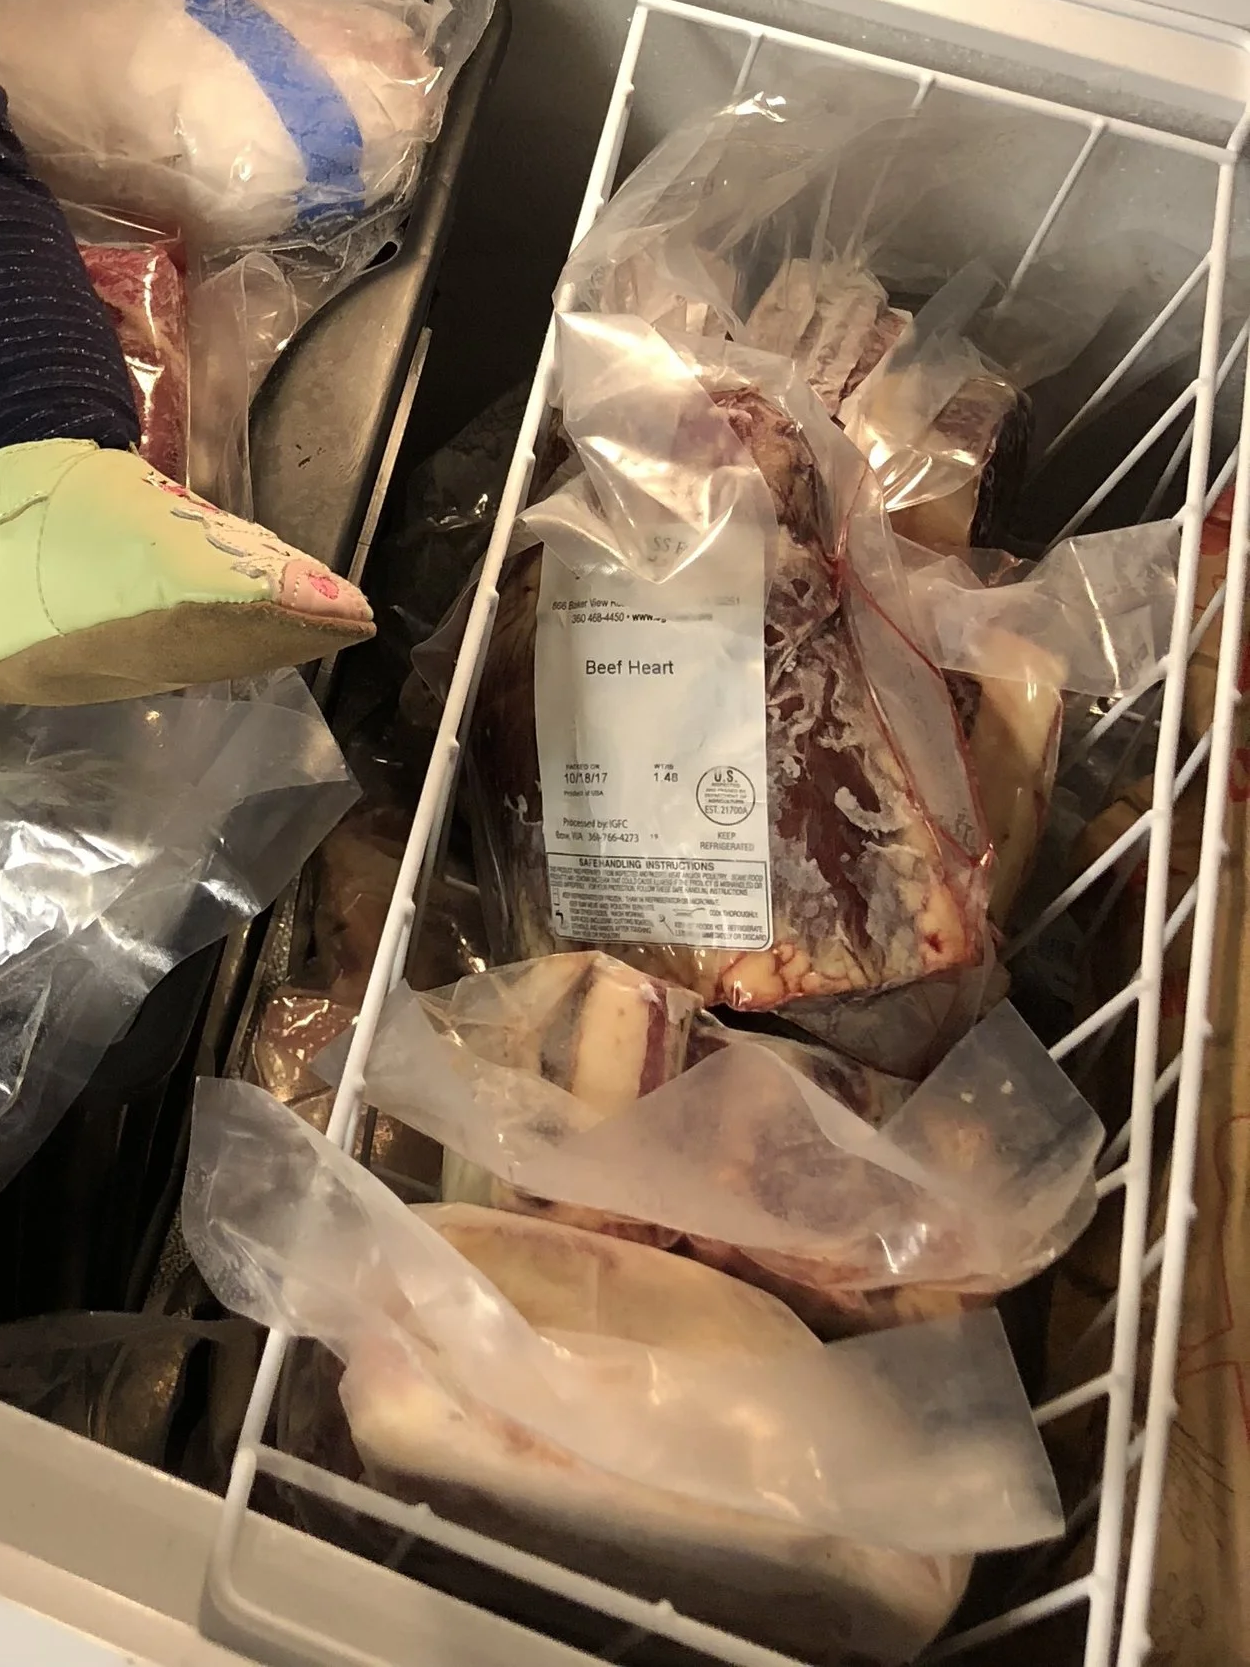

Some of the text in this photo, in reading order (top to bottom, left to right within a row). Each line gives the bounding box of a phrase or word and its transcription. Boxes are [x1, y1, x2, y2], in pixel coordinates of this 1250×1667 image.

[585, 660, 674, 675] Beef Heart
[564, 772, 608, 784] 10/18/17
[714, 770, 738, 783] U.S.
[562, 817, 596, 829] Processed
[609, 819, 629, 828] IGFC
[717, 832, 736, 840] KEEP
[699, 842, 755, 852] REFRIGERATED
[578, 858, 715, 872] SAFE HANDLING INSTRUCTIONS
